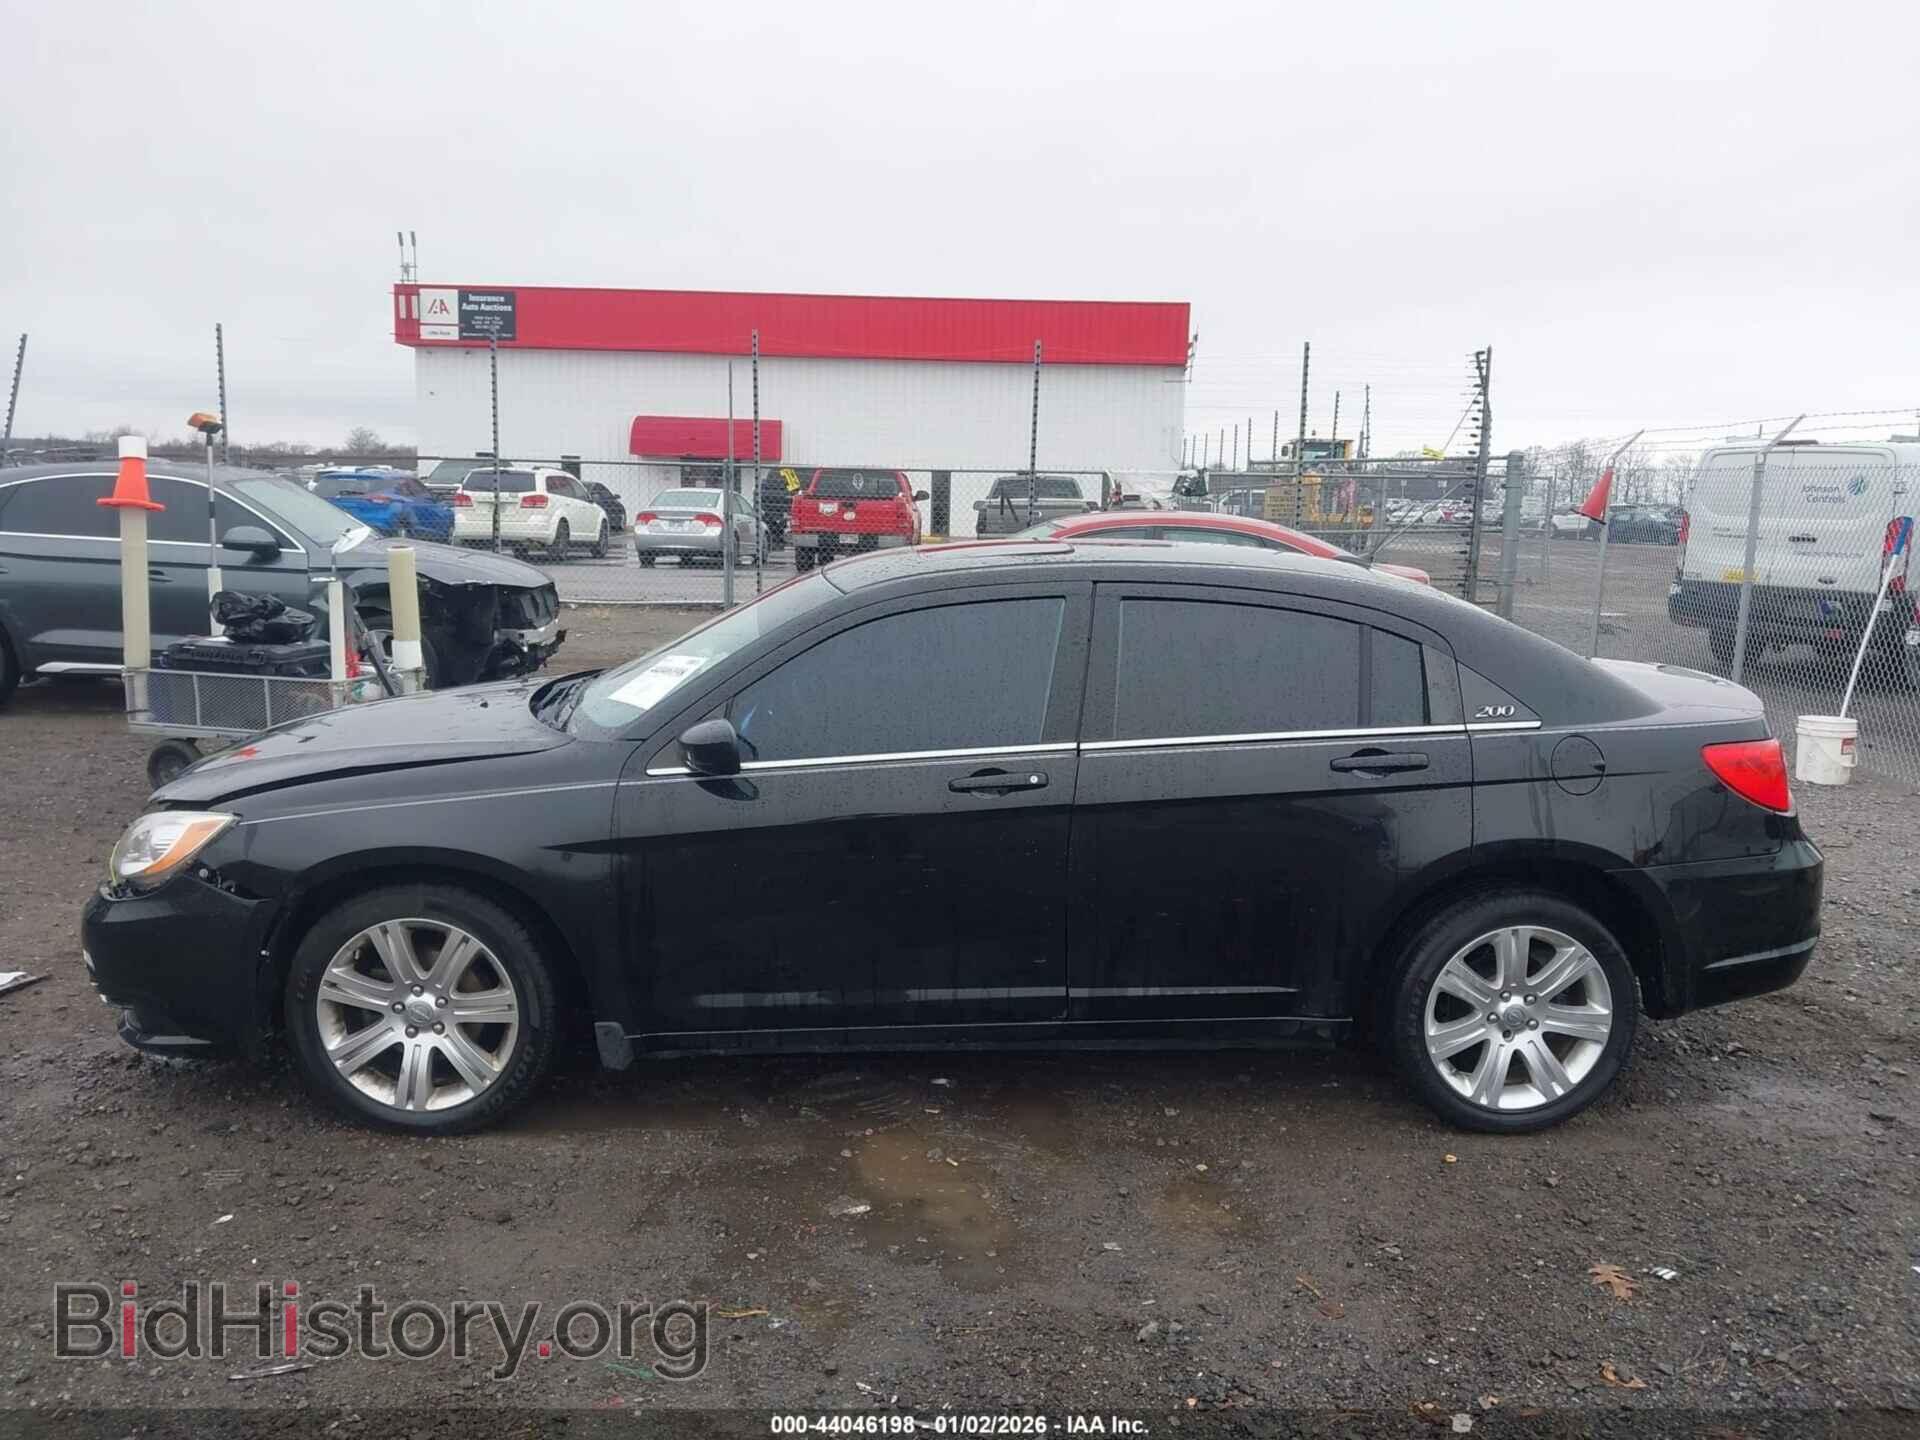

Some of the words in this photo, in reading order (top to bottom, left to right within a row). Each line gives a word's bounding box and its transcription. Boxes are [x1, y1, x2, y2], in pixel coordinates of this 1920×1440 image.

[468, 294, 505, 302] Insurance
[462, 303, 479, 311] Auto
[480, 303, 512, 312] Auctions
[1801, 485, 1840, 494] Johnson
[1806, 495, 1847, 504] Controls
[1475, 705, 1514, 718] 200
